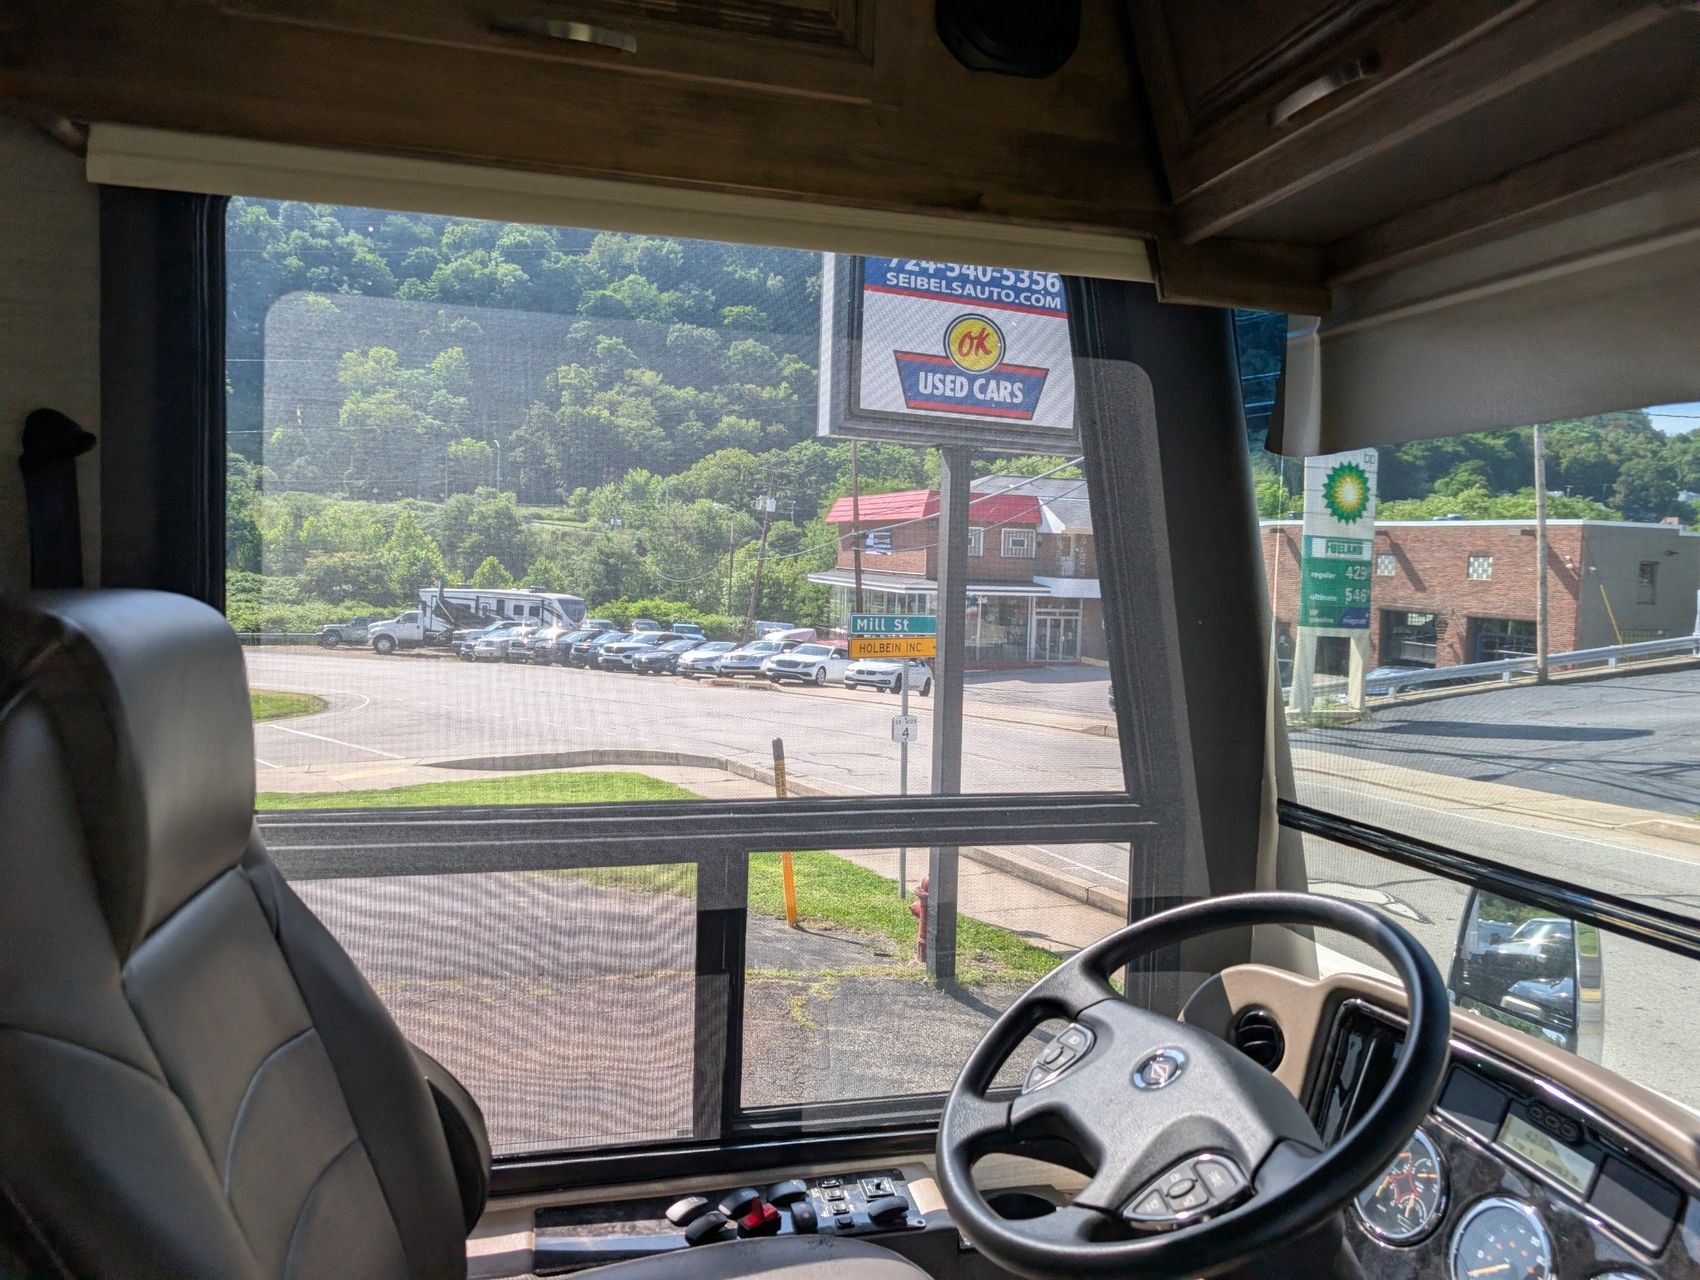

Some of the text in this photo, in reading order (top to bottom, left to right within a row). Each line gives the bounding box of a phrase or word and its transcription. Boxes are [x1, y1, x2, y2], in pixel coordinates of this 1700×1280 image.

[886, 272, 1061, 309] SEIBELSAUTO.COM
[957, 327, 993, 357] OK
[918, 371, 1024, 404] USED CARS
[857, 617, 909, 632] Mill St
[859, 642, 922, 653] HOLBEIN INC
[901, 727, 910, 738] 4
